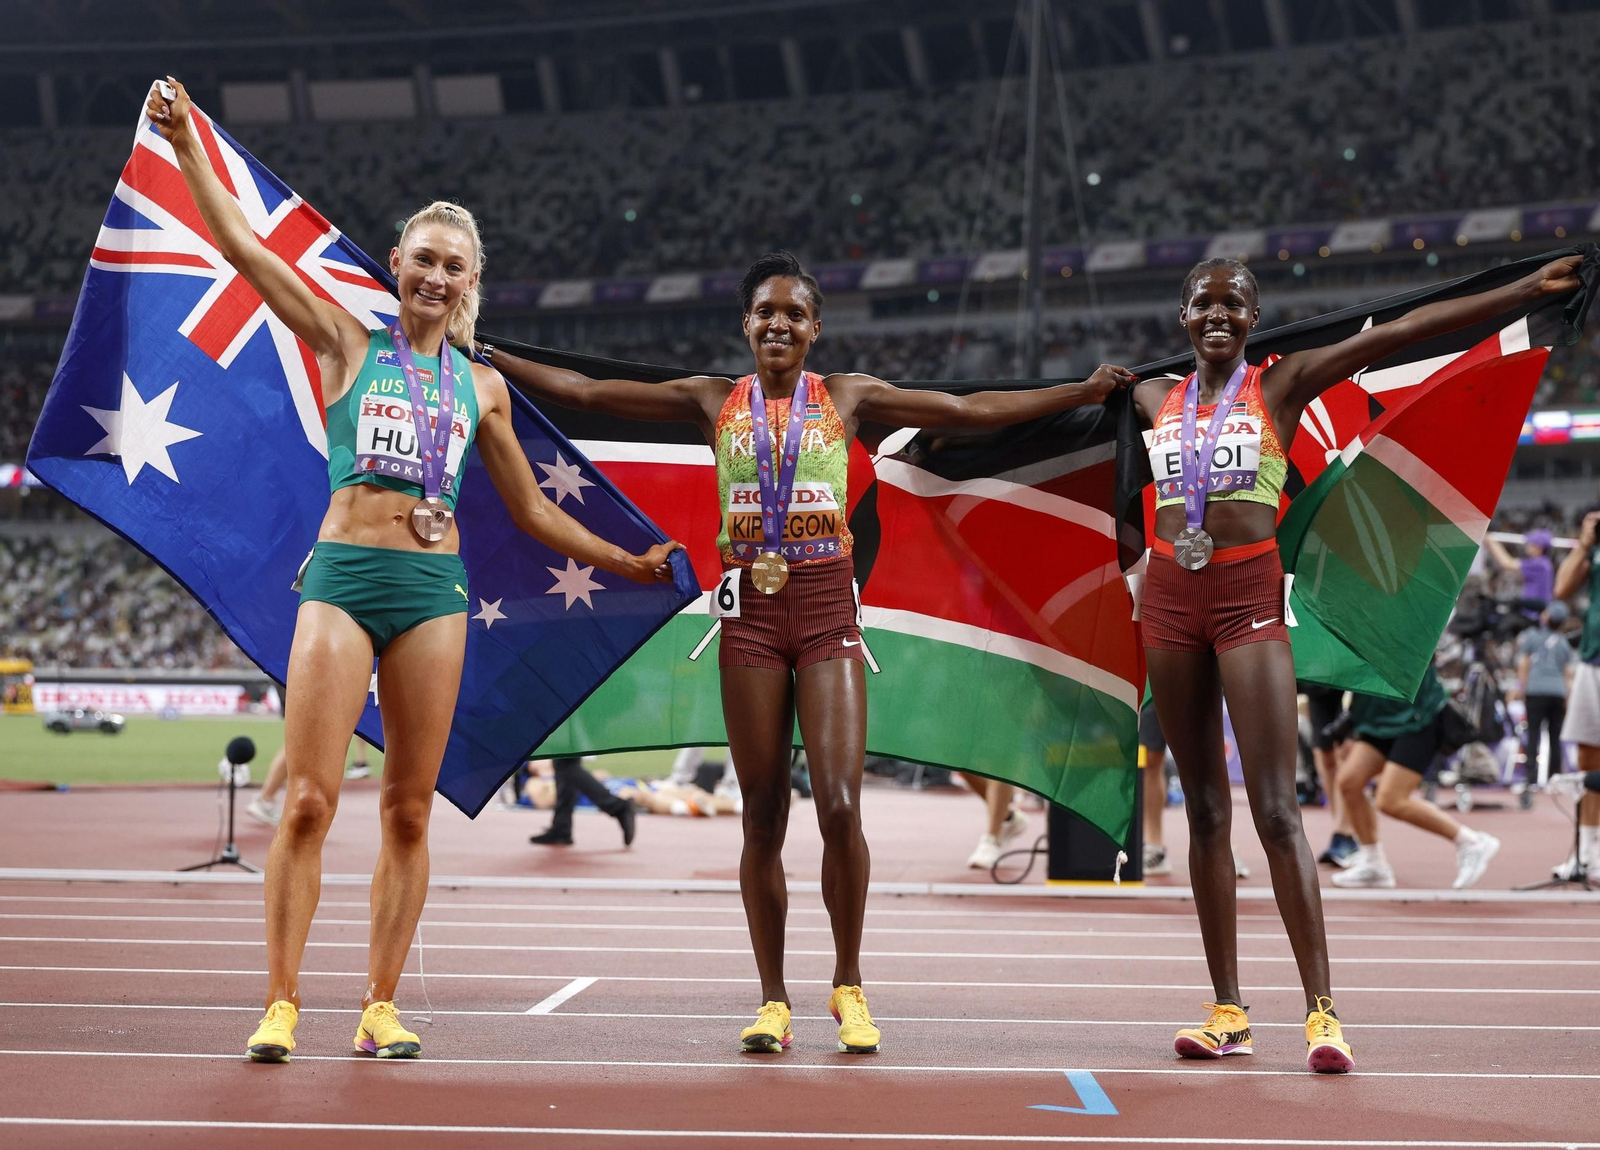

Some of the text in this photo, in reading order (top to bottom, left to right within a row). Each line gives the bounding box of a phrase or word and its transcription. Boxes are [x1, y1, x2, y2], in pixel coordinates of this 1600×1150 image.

[367, 378, 469, 418] AUSRAIA
[371, 427, 448, 468] HU
[1165, 444, 1242, 476] EOI
[379, 460, 424, 479] TOKY
[731, 489, 834, 505] HDA
[733, 513, 836, 539] KIPEGON
[755, 544, 815, 557] TKYO
[717, 575, 735, 611] 6
